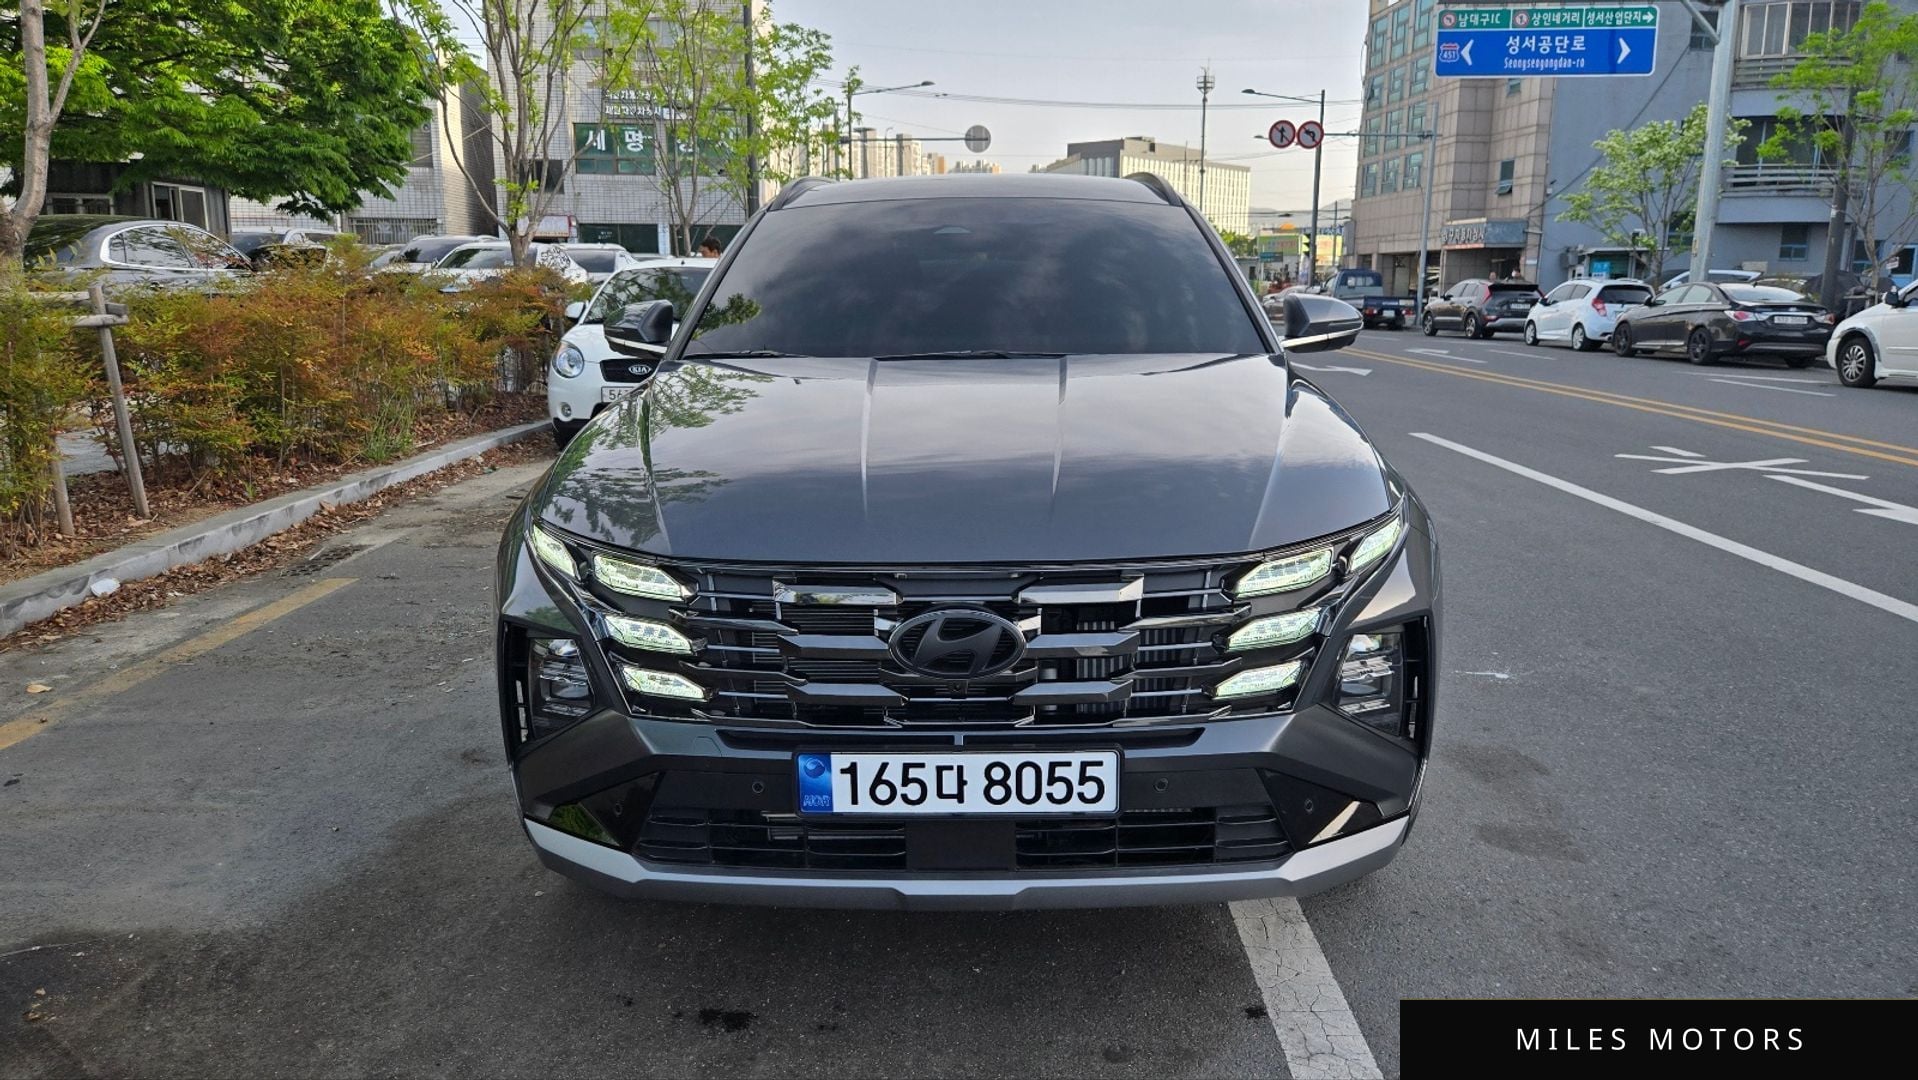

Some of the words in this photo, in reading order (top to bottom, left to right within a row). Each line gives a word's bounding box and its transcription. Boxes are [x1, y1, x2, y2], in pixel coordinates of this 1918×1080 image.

[1458, 15, 1501, 28] 남대구IC
[1531, 11, 1580, 26] 상인네거리
[1586, 11, 1642, 25] 성서산업단지
[1506, 35, 1586, 55] 성서공단로
[840, 761, 968, 806] 165다
[983, 760, 1105, 806] 8055
